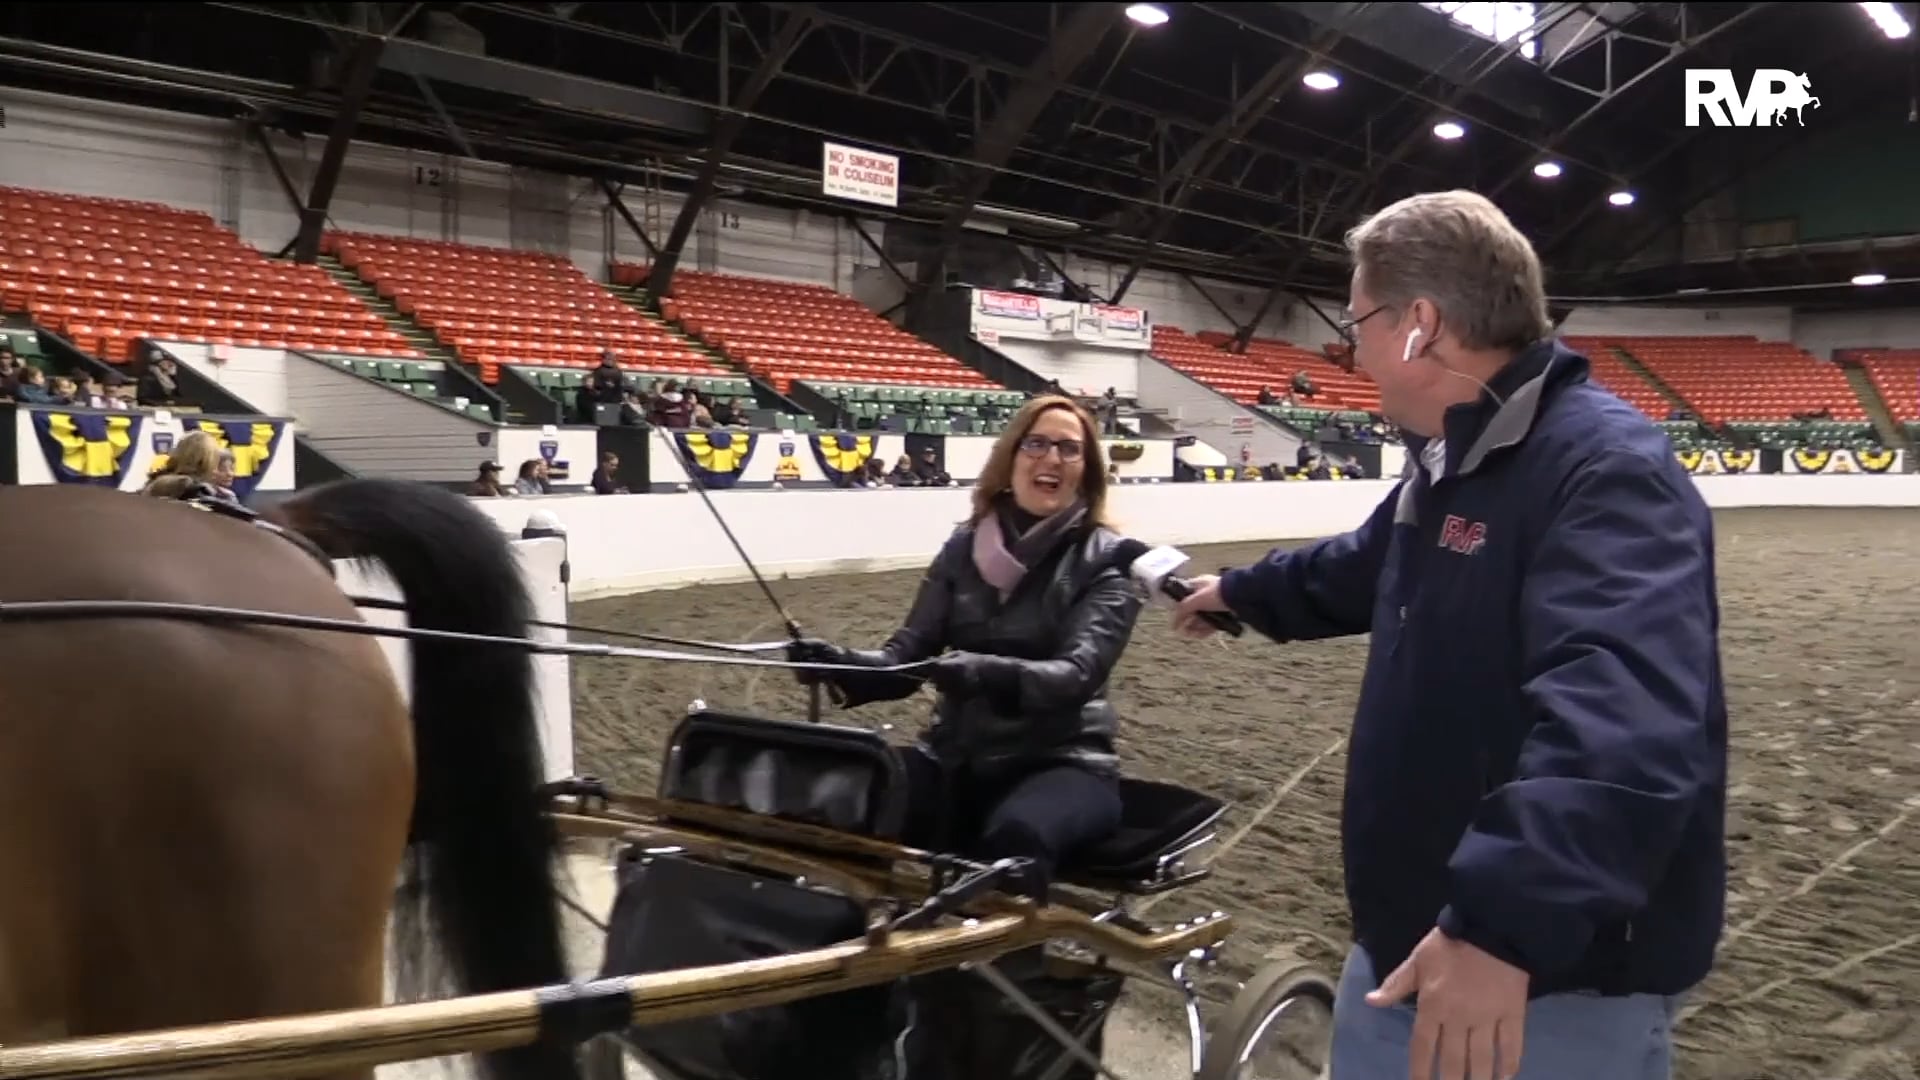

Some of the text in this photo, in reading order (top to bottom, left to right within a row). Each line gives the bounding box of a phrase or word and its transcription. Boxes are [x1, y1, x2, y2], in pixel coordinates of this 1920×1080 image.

[830, 151, 894, 173] NO SMOKING
[416, 166, 440, 187] 12
[828, 164, 894, 187] IN COLISEUM
[721, 211, 740, 231] 13
[1438, 514, 1487, 555] RVP
